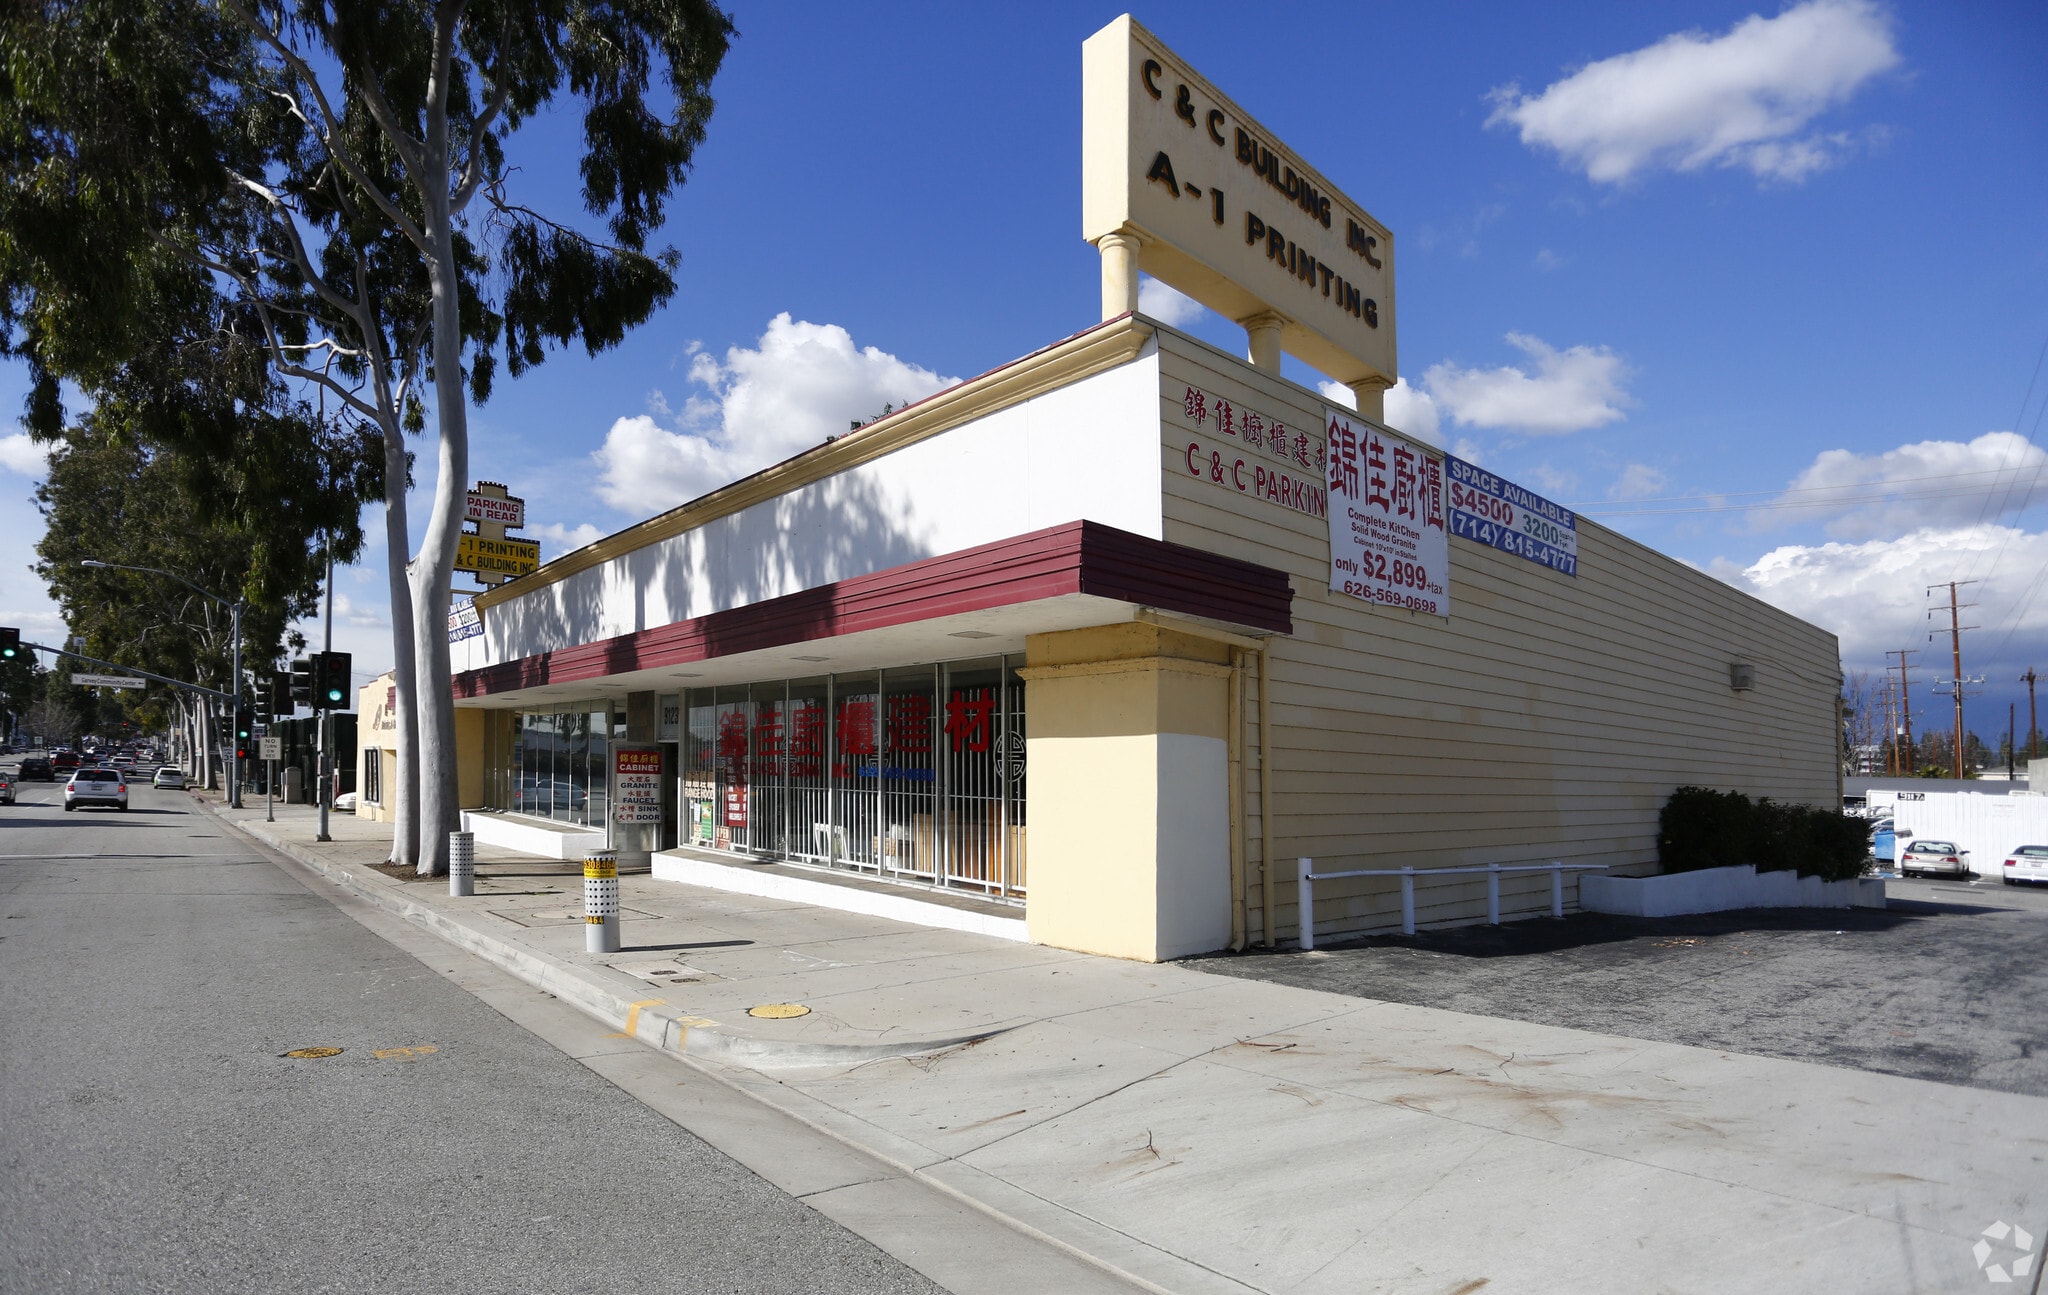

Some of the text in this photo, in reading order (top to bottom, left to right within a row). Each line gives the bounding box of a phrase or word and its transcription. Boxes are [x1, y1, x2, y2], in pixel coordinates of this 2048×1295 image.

[1141, 59, 1162, 101] C
[1174, 84, 1197, 128] &
[1206, 109, 1225, 147] C
[1235, 127, 1331, 229] BUILDING
[1146, 151, 1378, 329] A-1 PRINTING
[1187, 442, 1326, 518] C & C PARKIN
[1451, 460, 1571, 527] SPACE AVAILABLE
[467, 496, 520, 513] PARKING
[469, 507, 517, 522] IN REAR
[1347, 506, 1387, 530] Complete
[1451, 481, 1560, 545] $4500 3200
[461, 539, 535, 559] -1 PRINTING
[1351, 521, 1417, 551] Solid Wood Granite
[1353, 535, 1375, 549] Cabinet
[1449, 508, 1575, 573] (714) 815-4777
[456, 553, 464, 566] &
[467, 554, 474, 567] C
[477, 556, 517, 572] BUILDING
[1335, 558, 1359, 577] only
[1362, 549, 1427, 591] $2,899
[1343, 580, 1437, 614] 626-569-0698
[619, 764, 660, 772] CABINET
